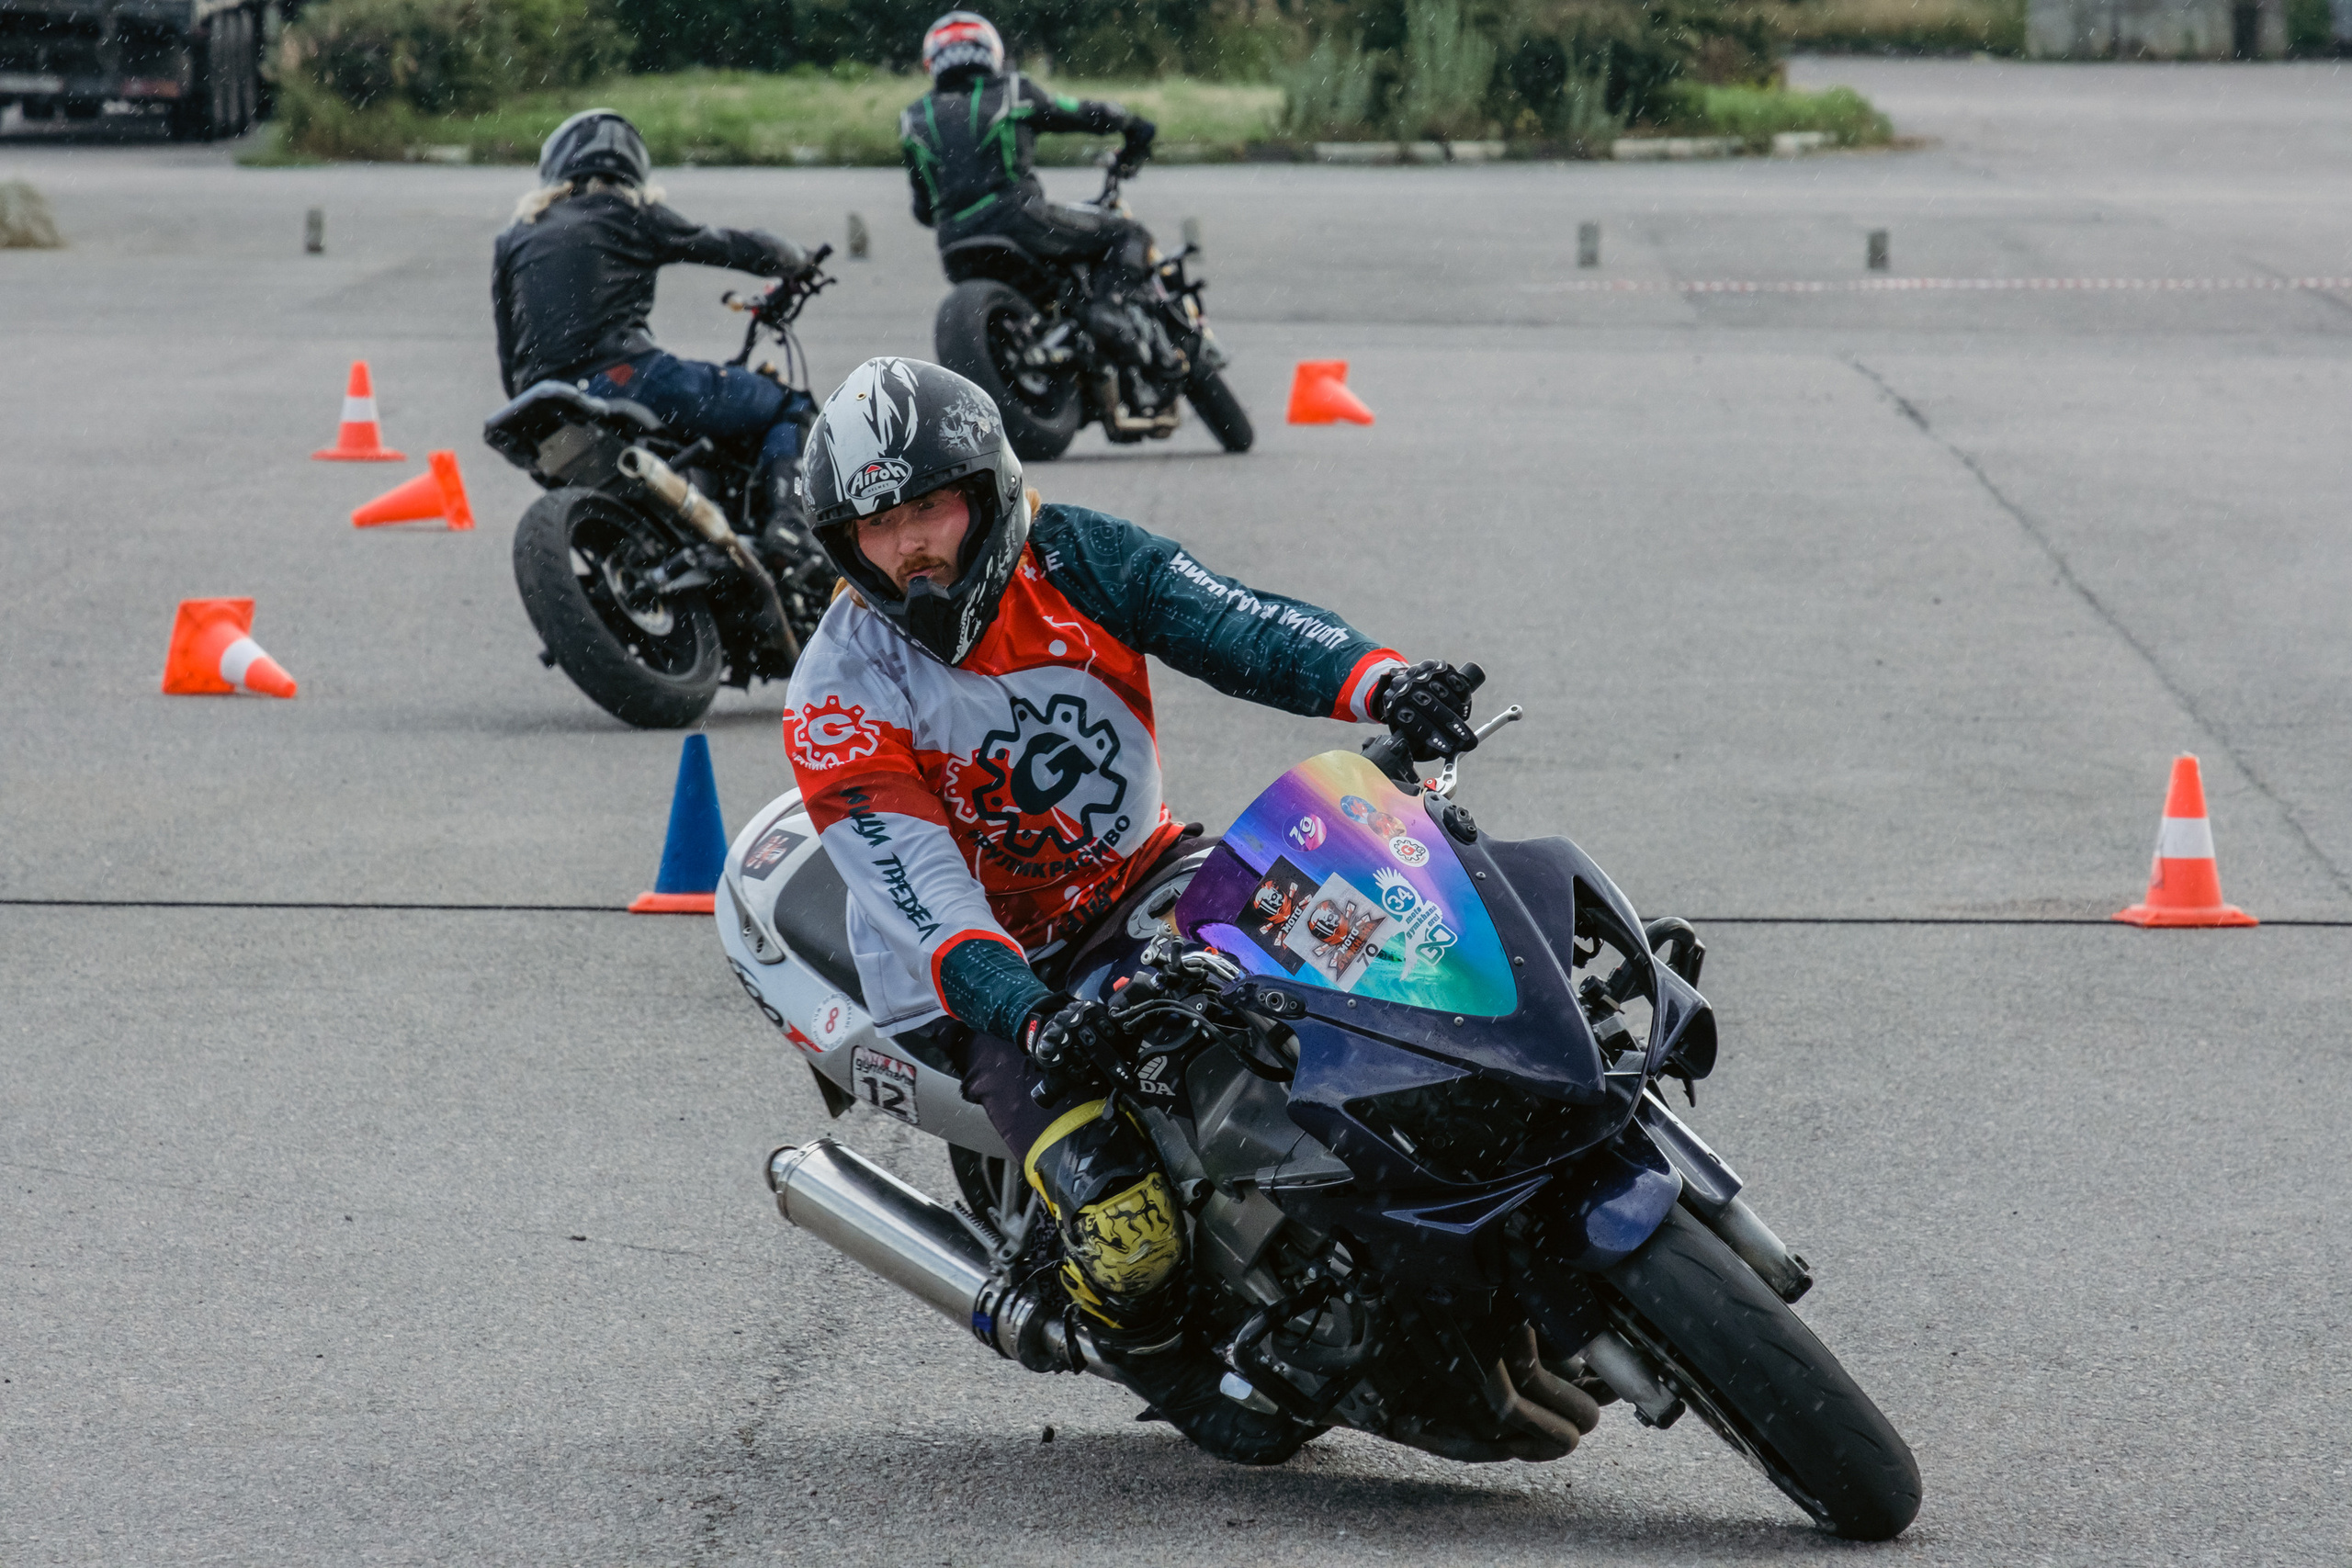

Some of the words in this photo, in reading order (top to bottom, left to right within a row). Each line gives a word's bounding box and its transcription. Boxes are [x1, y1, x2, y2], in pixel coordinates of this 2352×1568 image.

[851, 461, 907, 495] Airoh
[867, 482, 890, 494] HELMET
[1386, 886, 1414, 910] 34
[1281, 905, 1303, 934] MOTO
[1405, 906, 1422, 924] moto
[1406, 905, 1438, 940] gymkhana
[1427, 913, 1441, 928] orel
[1338, 926, 1360, 954] MOTO
[1356, 942, 1379, 968] 70
[860, 1076, 908, 1117] 12
